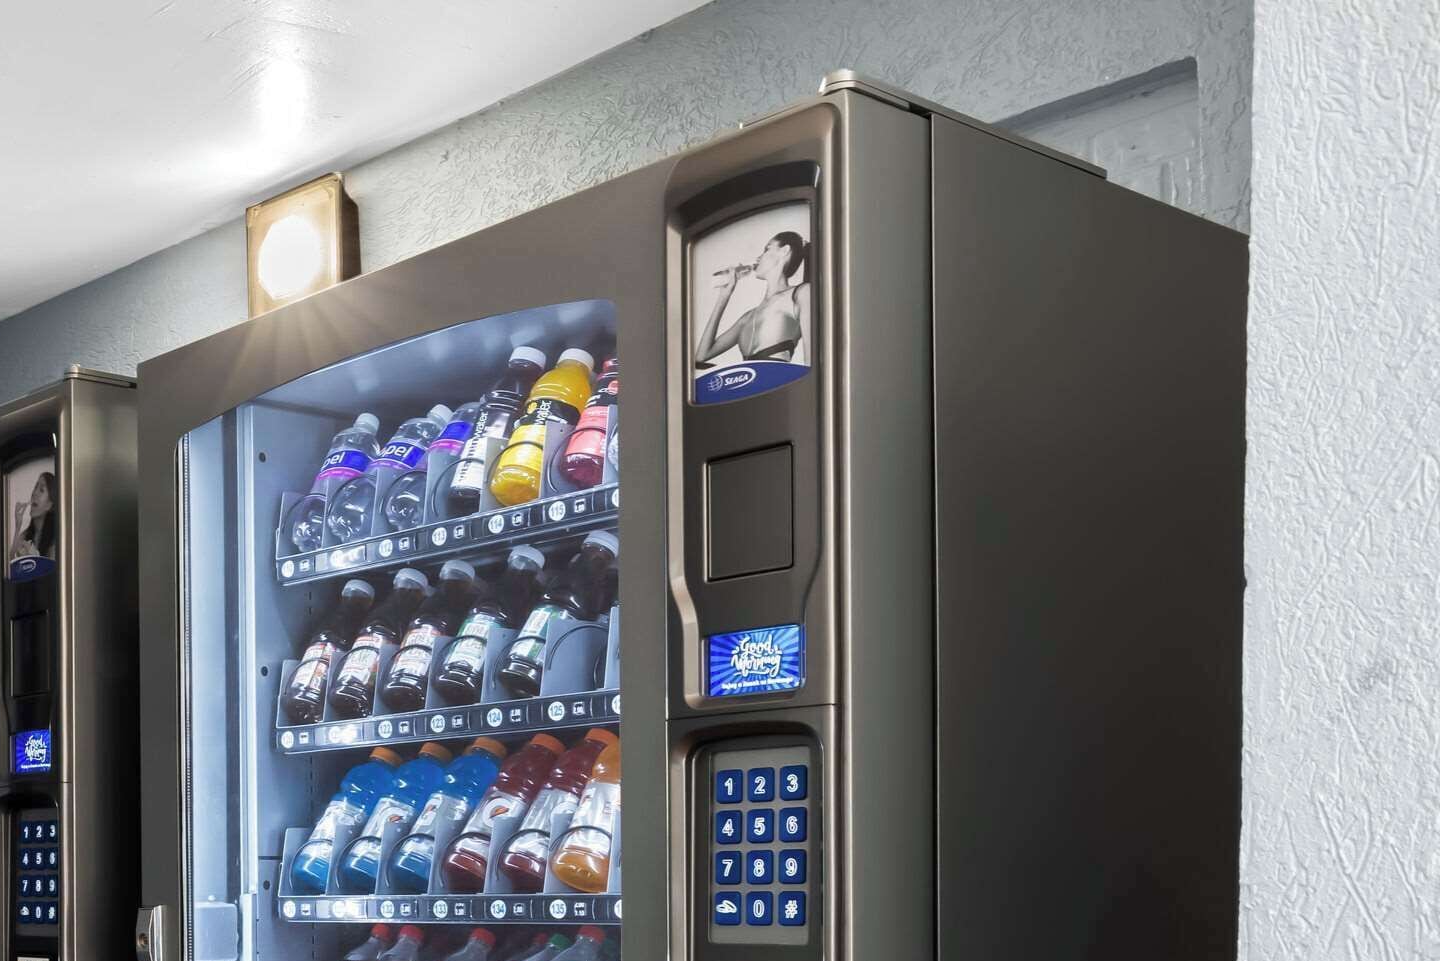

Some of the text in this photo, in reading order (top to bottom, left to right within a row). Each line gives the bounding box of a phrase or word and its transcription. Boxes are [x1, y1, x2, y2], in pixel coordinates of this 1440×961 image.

[724, 372, 749, 386] SEAGA
[740, 634, 773, 657] Good
[730, 654, 781, 677] Morning
[488, 712, 501, 722] 124
[724, 774, 798, 795] 1 2 3
[24, 825, 56, 838] 1 2 3
[722, 816, 798, 836] 4 5 6
[23, 852, 55, 865] 4 5 6
[722, 858, 798, 877] 7 8 9
[23, 880, 55, 892] 7 8 9
[36, 906, 41, 919] 0
[493, 904, 505, 915] 134
[752, 900, 765, 917] 0
